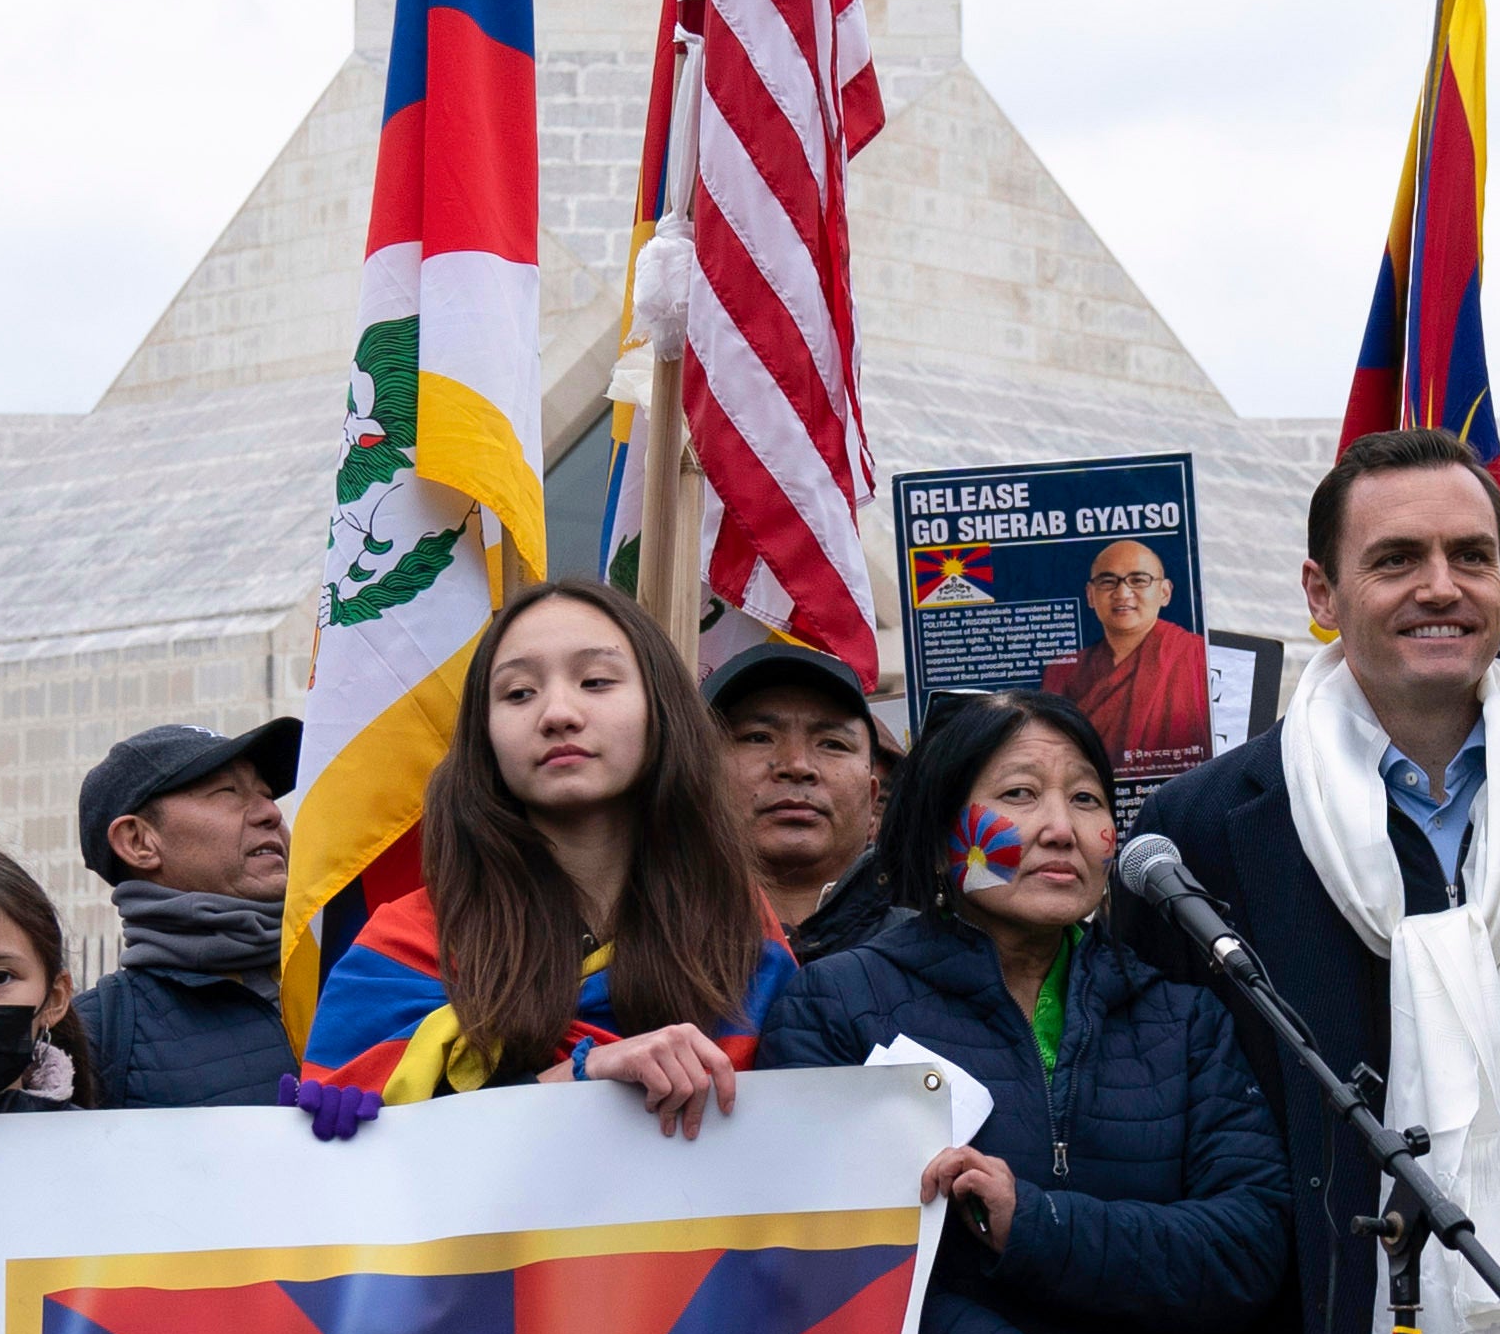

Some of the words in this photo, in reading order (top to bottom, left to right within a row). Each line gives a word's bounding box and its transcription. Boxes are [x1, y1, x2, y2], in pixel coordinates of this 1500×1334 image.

[910, 482, 1030, 515] RELEASE
[912, 519, 949, 545] GO
[957, 509, 1067, 541] SHERAB
[1075, 501, 1181, 531] GYATSO
